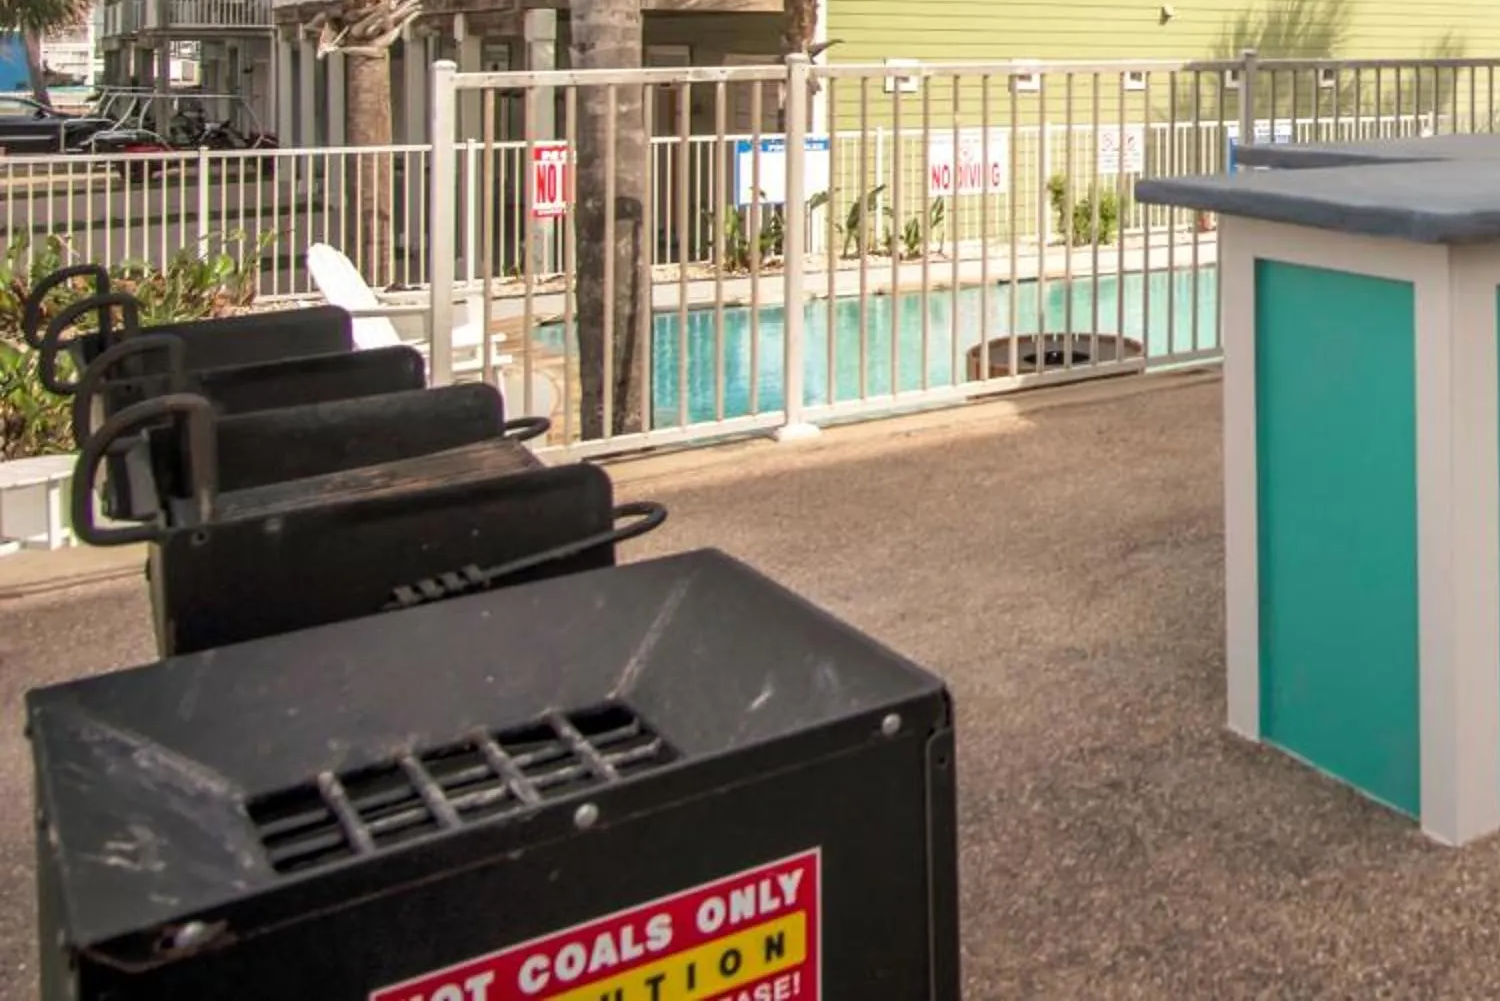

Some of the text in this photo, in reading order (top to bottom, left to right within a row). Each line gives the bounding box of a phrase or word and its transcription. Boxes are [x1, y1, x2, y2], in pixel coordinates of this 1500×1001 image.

[931, 162, 1001, 190] NO DIVIG
[517, 913, 673, 994] COALS
[696, 868, 804, 933] ONLY
